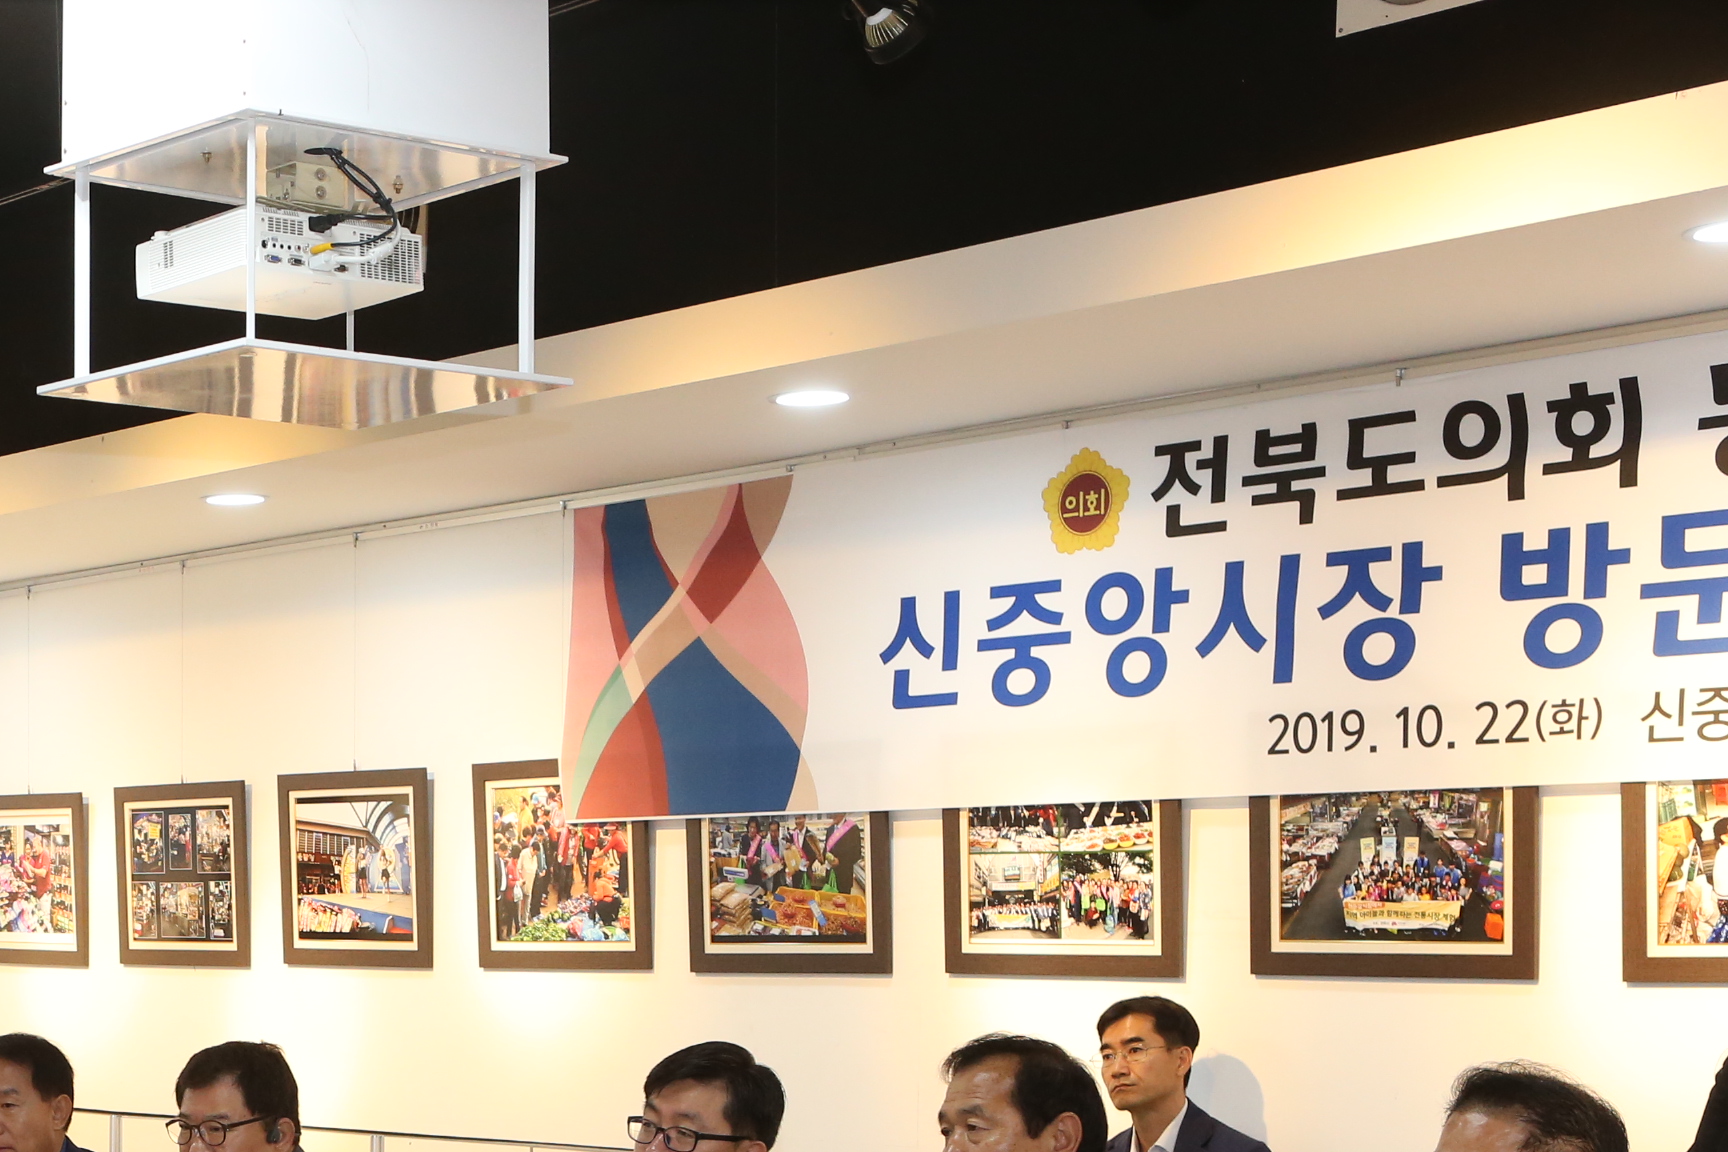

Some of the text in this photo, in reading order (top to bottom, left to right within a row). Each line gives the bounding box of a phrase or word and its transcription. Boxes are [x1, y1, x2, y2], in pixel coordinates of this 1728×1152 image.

[1062, 487, 1106, 518] 의회
[1151, 376, 1642, 538] 전북도의회
[879, 541, 1443, 710] 신중앙시장
[1267, 708, 1379, 757] 2019.
[1396, 703, 1457, 751] 10.
[1474, 697, 1604, 746] 22(화)
